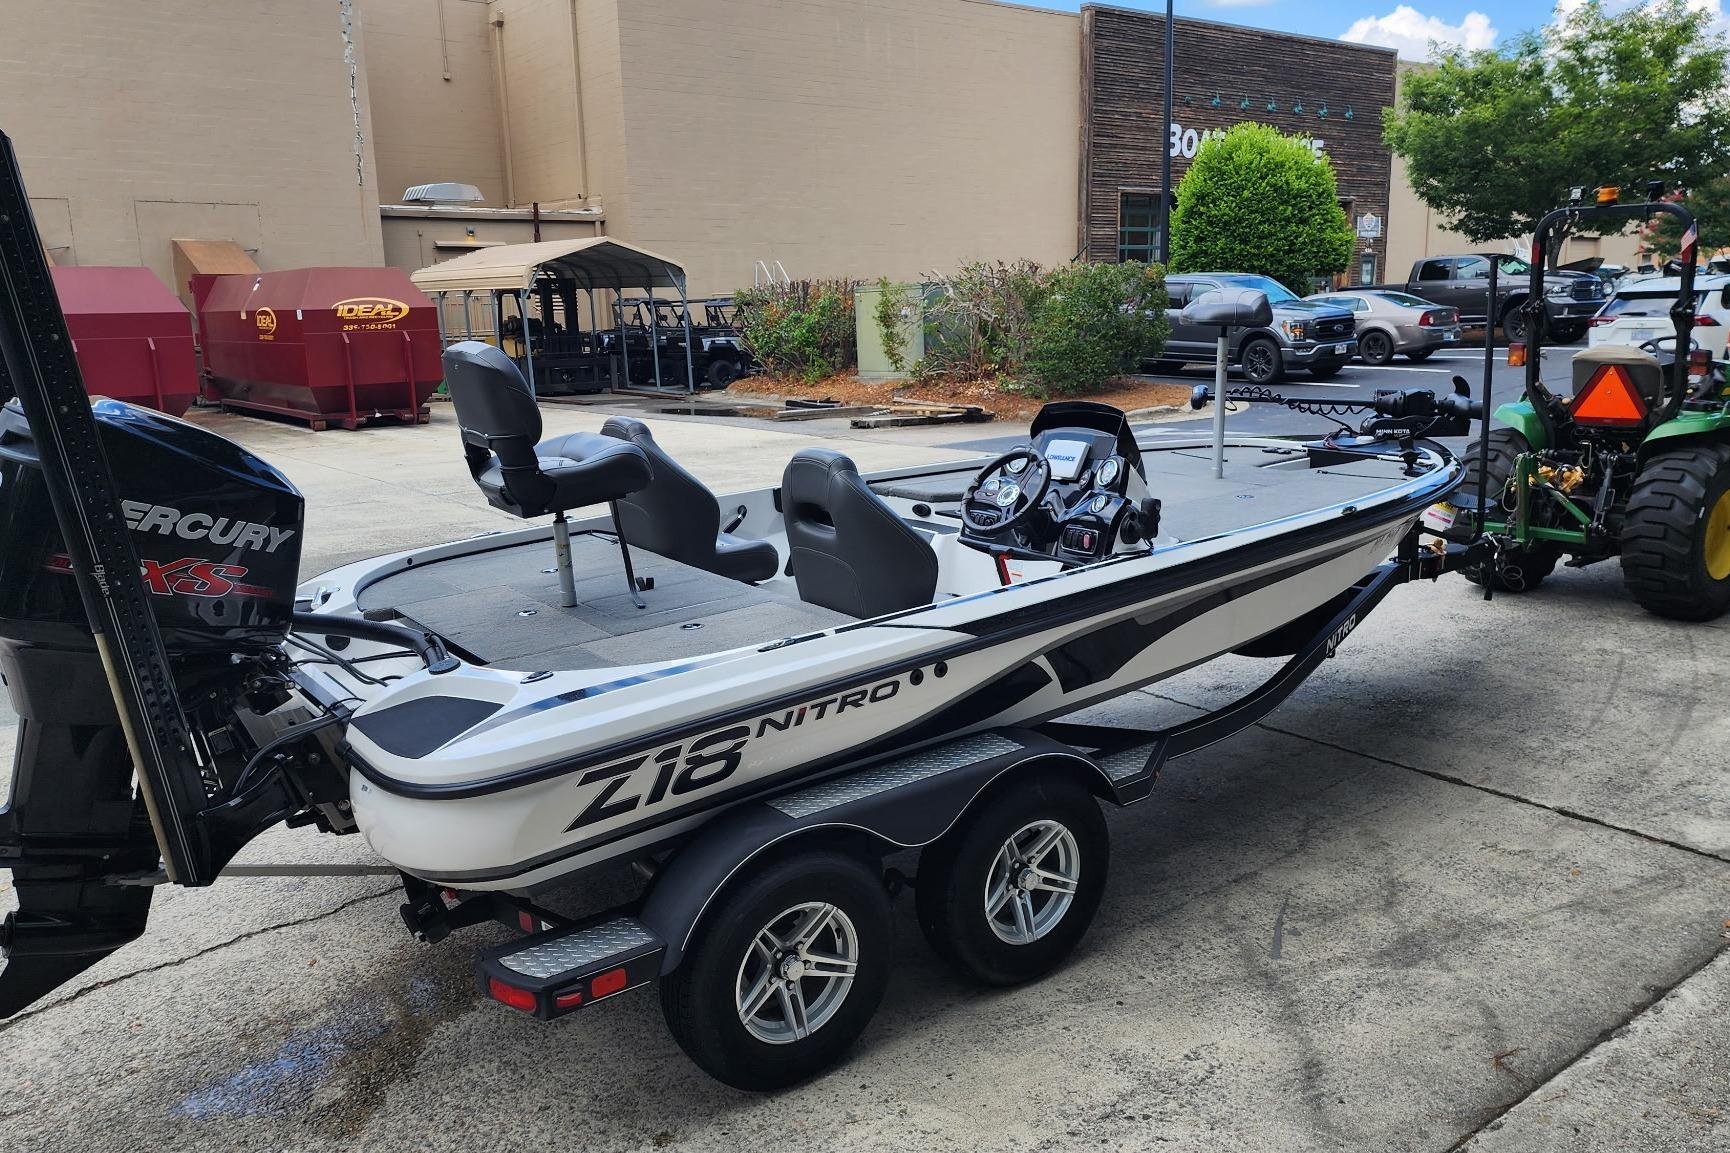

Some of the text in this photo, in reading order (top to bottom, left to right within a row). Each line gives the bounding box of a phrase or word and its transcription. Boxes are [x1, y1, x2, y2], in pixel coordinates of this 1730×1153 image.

[336, 304, 400, 317] IDEAL
[120, 499, 296, 553] ERCURY
[1325, 613, 1357, 655] NITRO
[560, 680, 901, 834] Z18 NITRO
